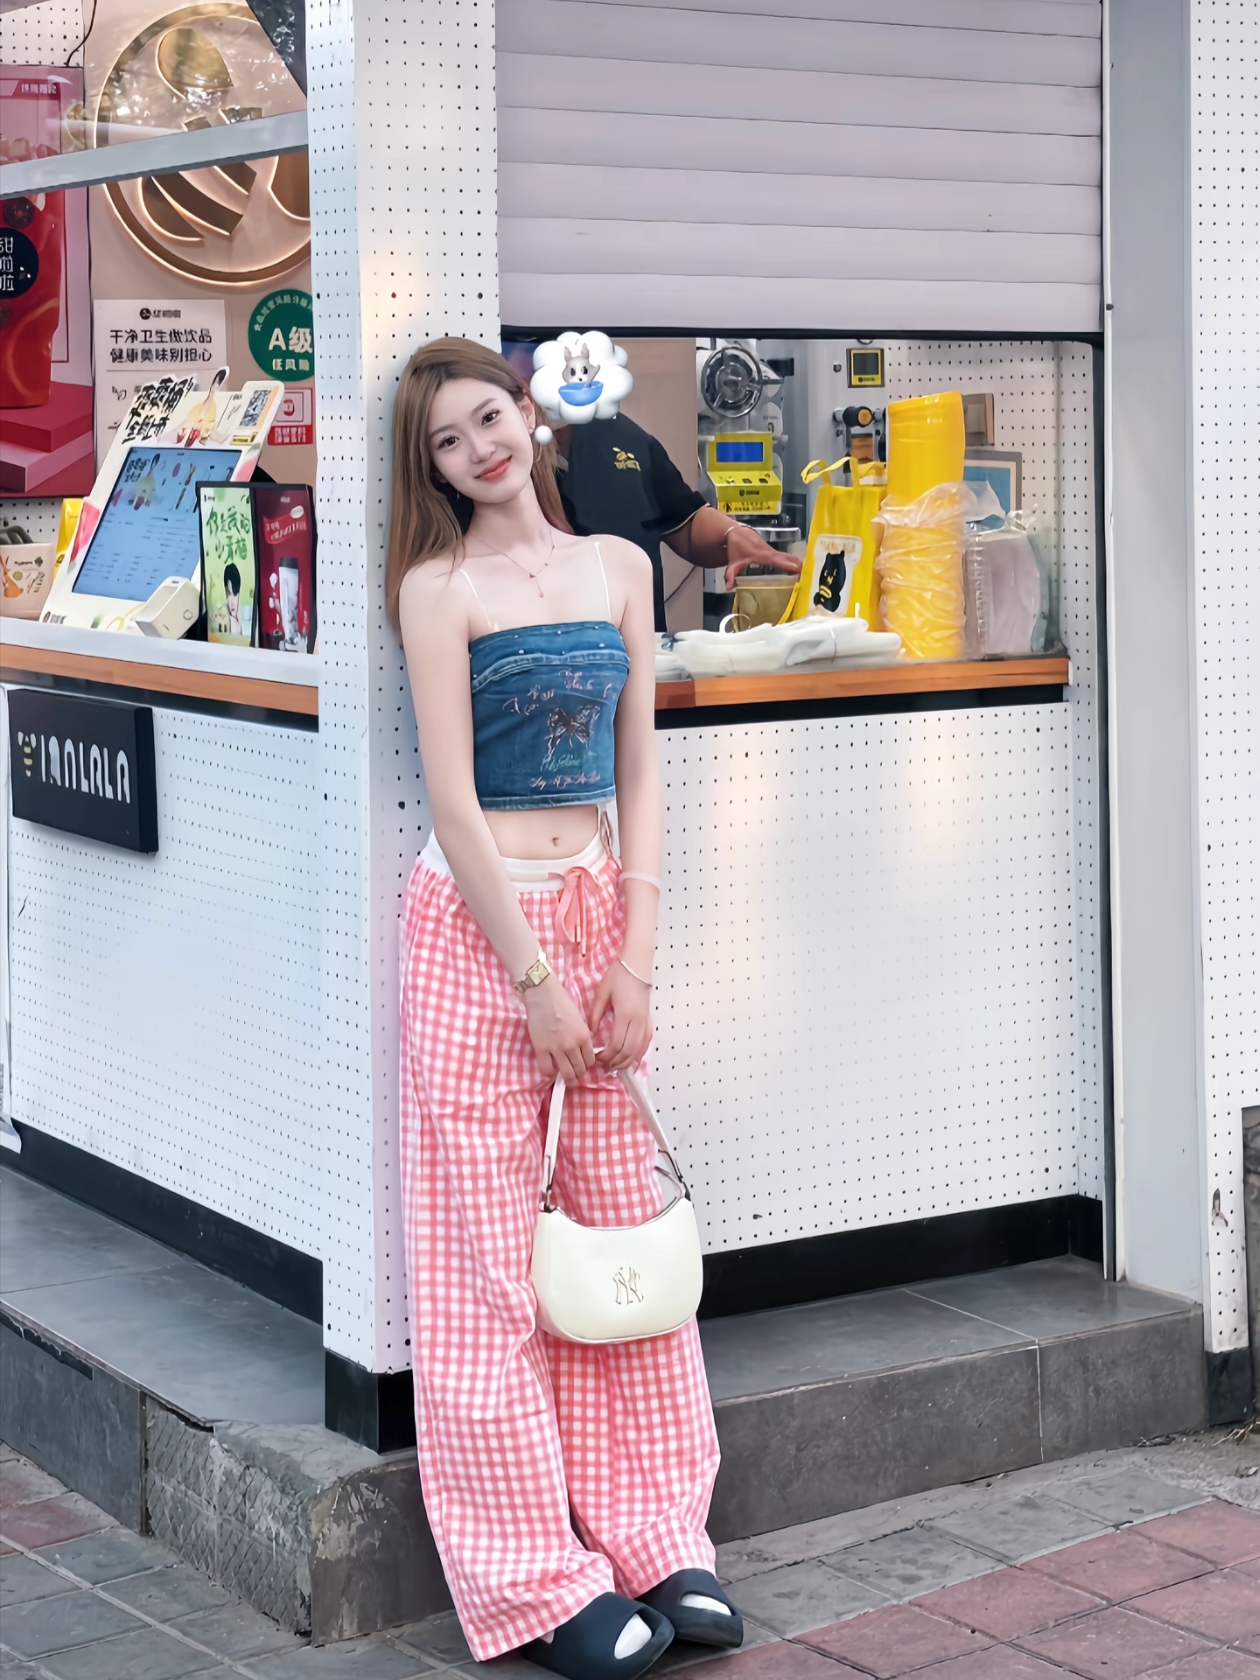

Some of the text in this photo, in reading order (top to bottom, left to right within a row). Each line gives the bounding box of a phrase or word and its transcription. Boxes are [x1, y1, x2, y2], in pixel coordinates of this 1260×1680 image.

[110, 328, 212, 344] 干净卫生做饮品
[268, 325, 313, 353] A级
[110, 347, 212, 363] 健康美味别担心
